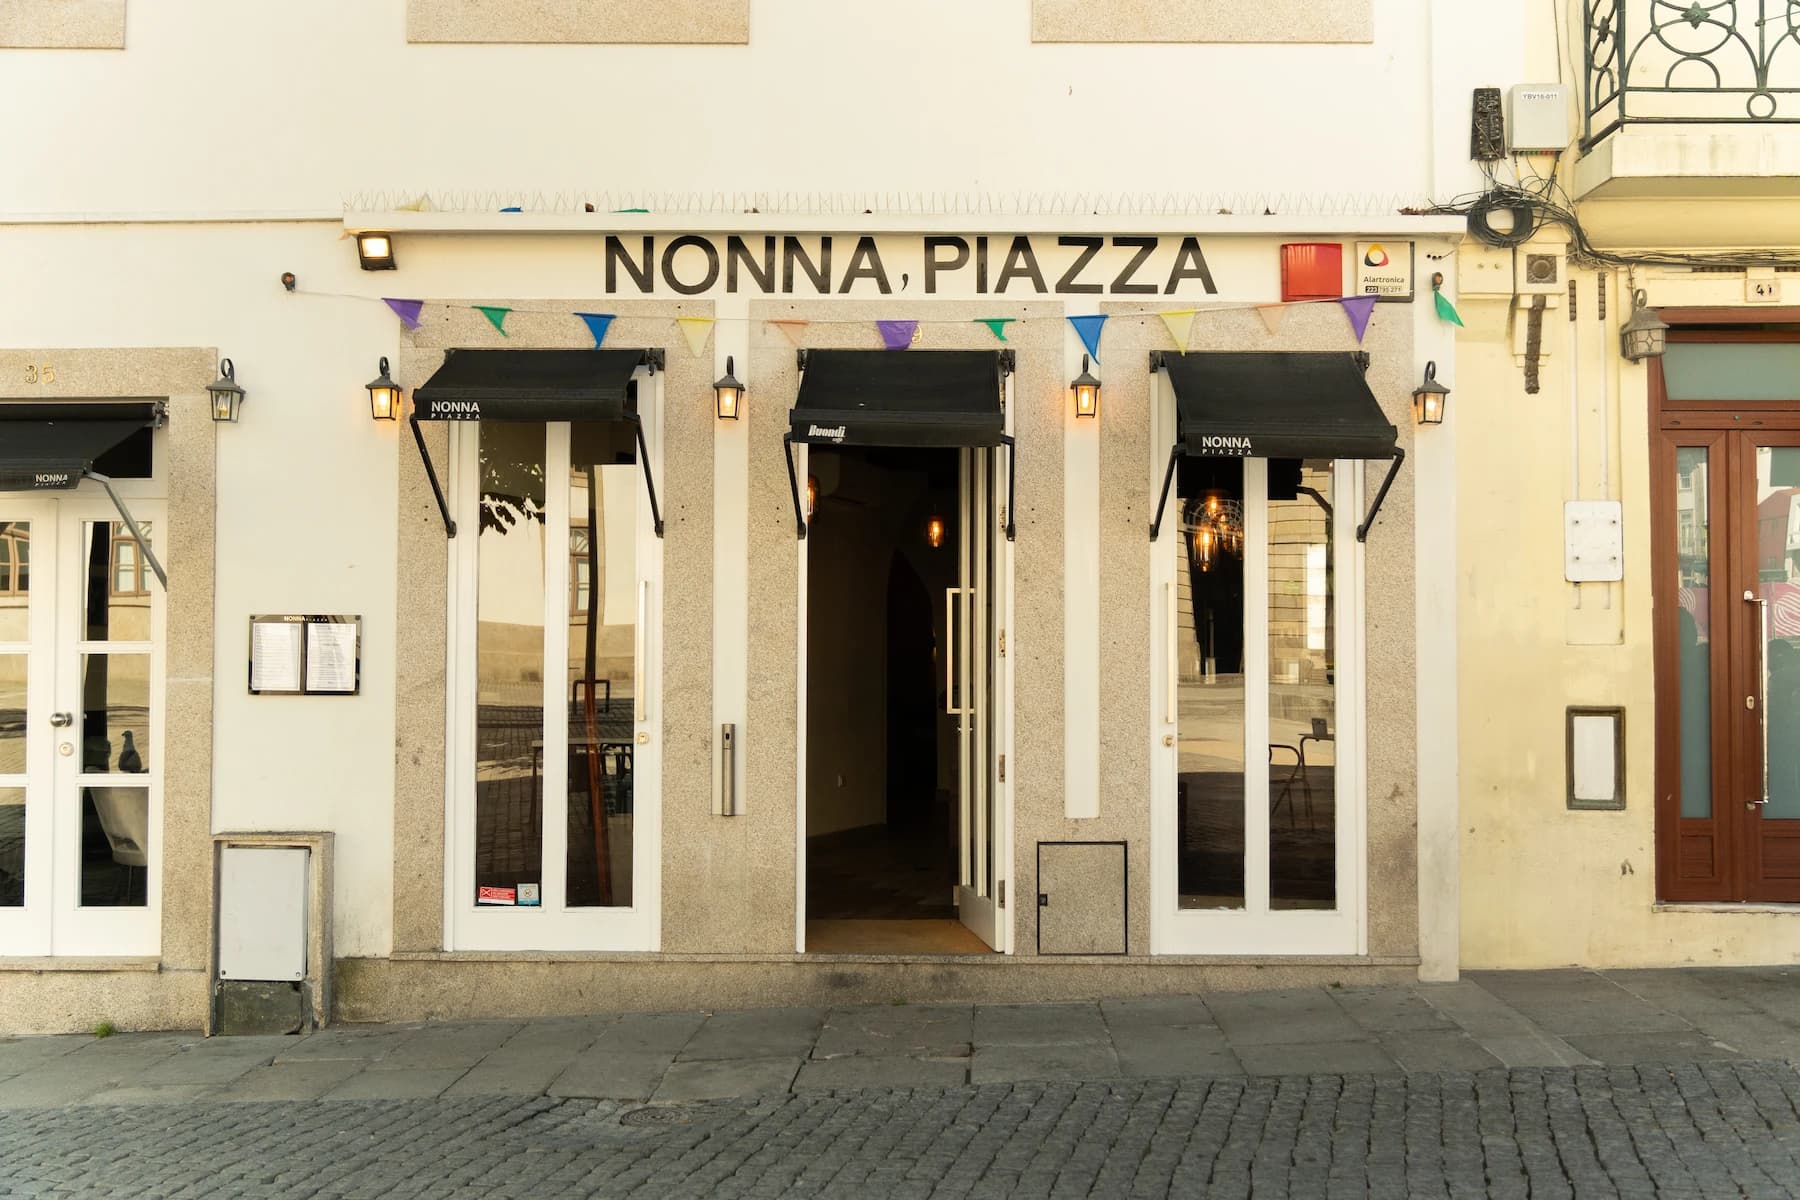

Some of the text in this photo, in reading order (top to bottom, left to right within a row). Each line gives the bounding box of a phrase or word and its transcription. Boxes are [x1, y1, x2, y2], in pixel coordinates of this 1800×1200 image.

[923, 235, 1218, 295] PIAZZA
[25, 364, 55, 383] 35
[431, 401, 480, 413] NONNA
[1202, 436, 1252, 448] NONNA
[35, 474, 68, 482] NONNA
